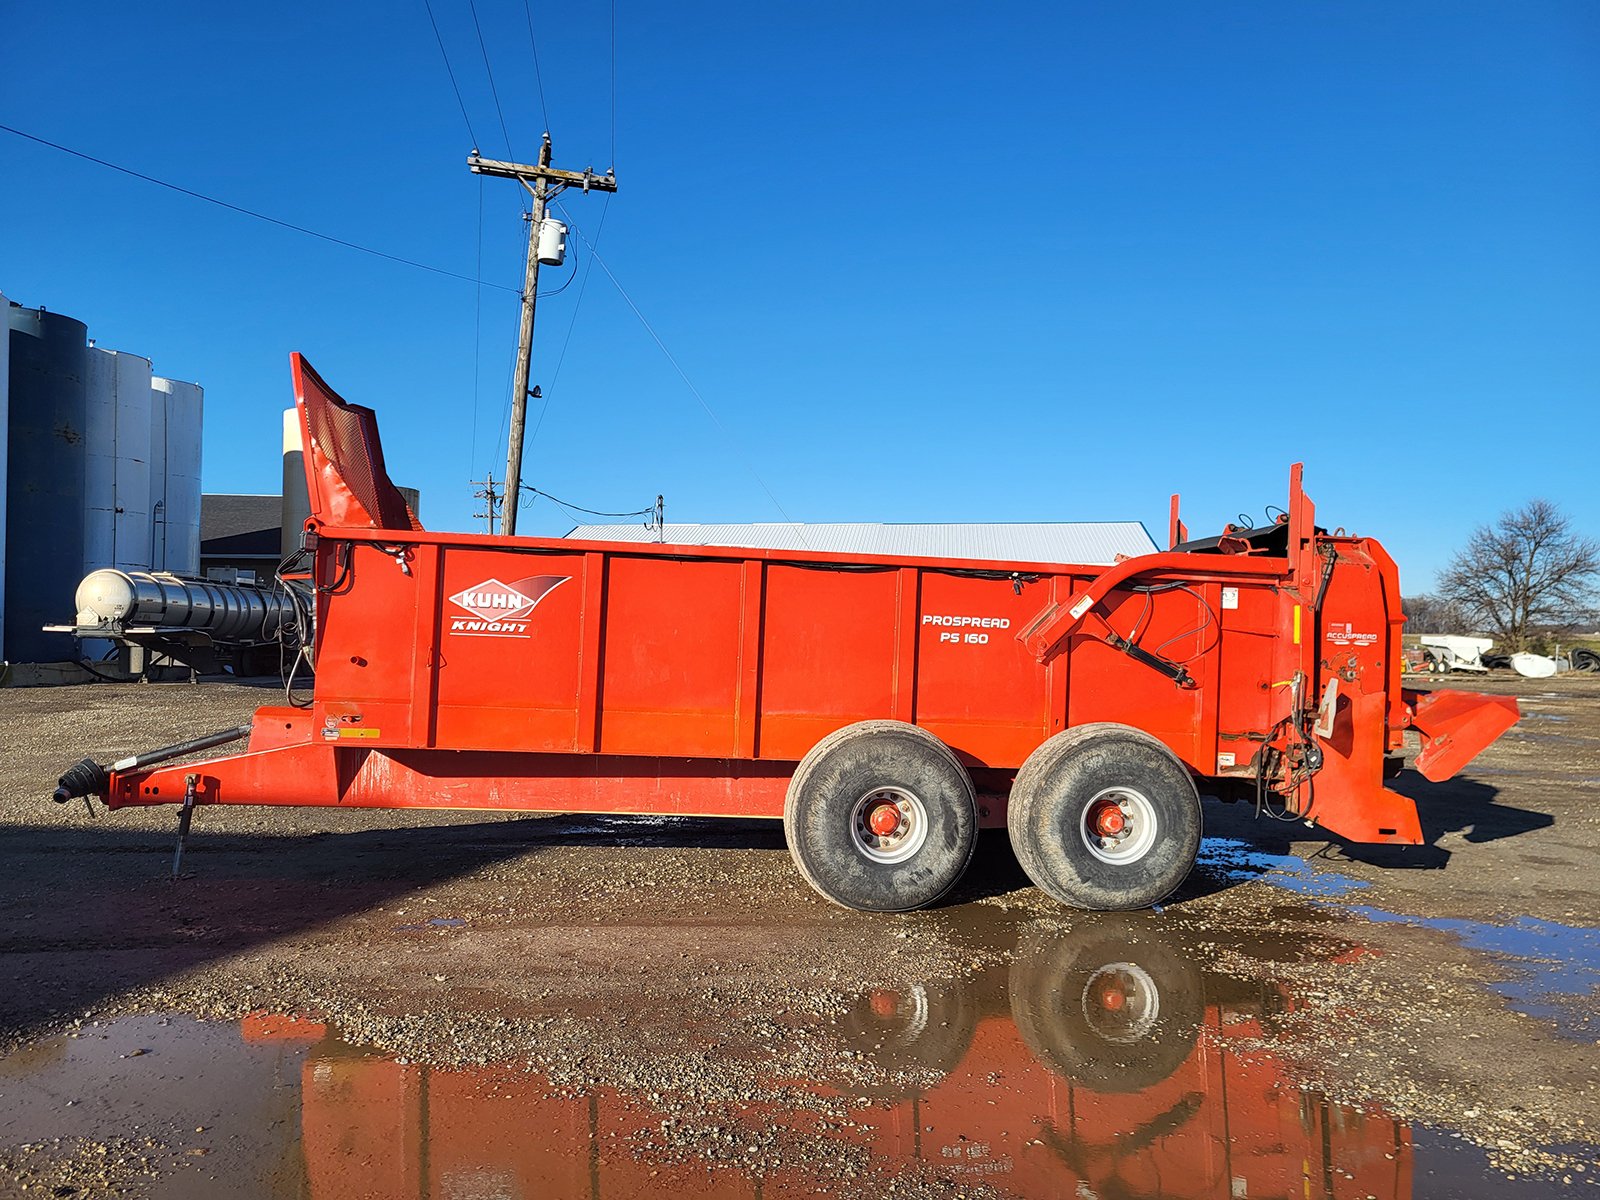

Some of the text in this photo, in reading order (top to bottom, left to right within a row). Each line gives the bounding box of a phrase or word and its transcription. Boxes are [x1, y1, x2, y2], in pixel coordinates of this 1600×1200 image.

[462, 592, 523, 609] KUHN
[451, 621, 527, 633] KNIGHT
[922, 615, 1011, 629] PROSPREAD
[940, 632, 989, 644] PS 160
[1326, 632, 1378, 640] ACCUSPREAD
